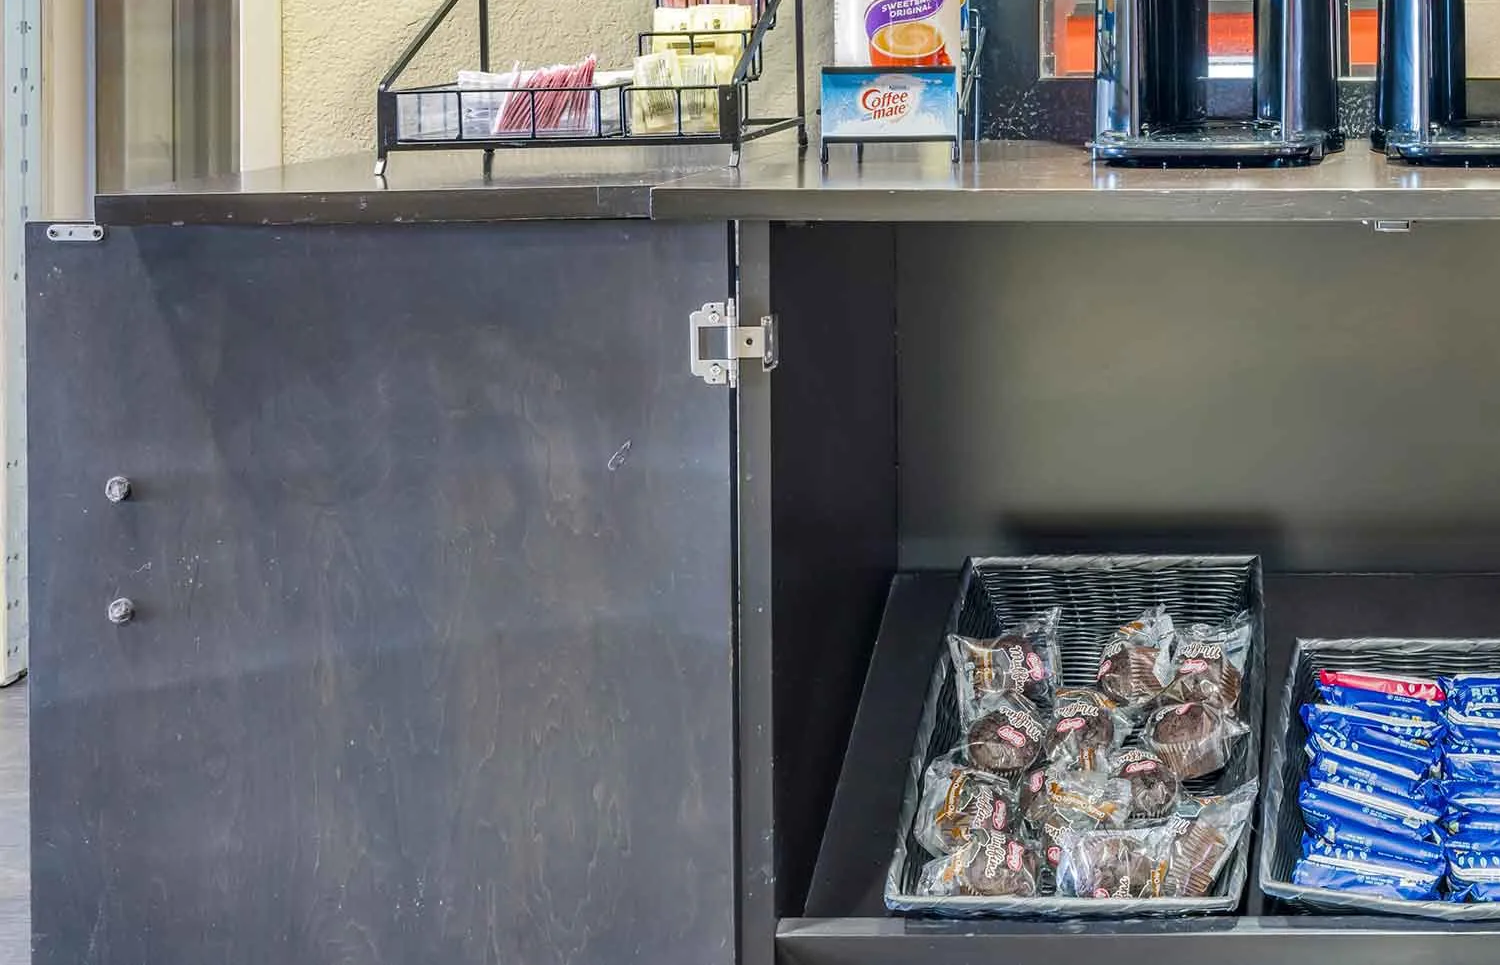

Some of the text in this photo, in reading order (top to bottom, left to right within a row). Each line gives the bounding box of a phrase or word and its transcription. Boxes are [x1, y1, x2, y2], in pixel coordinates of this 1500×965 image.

[889, 3, 933, 18] ORIGINAL
[862, 88, 908, 111] Coffee
[872, 104, 906, 120] mate
